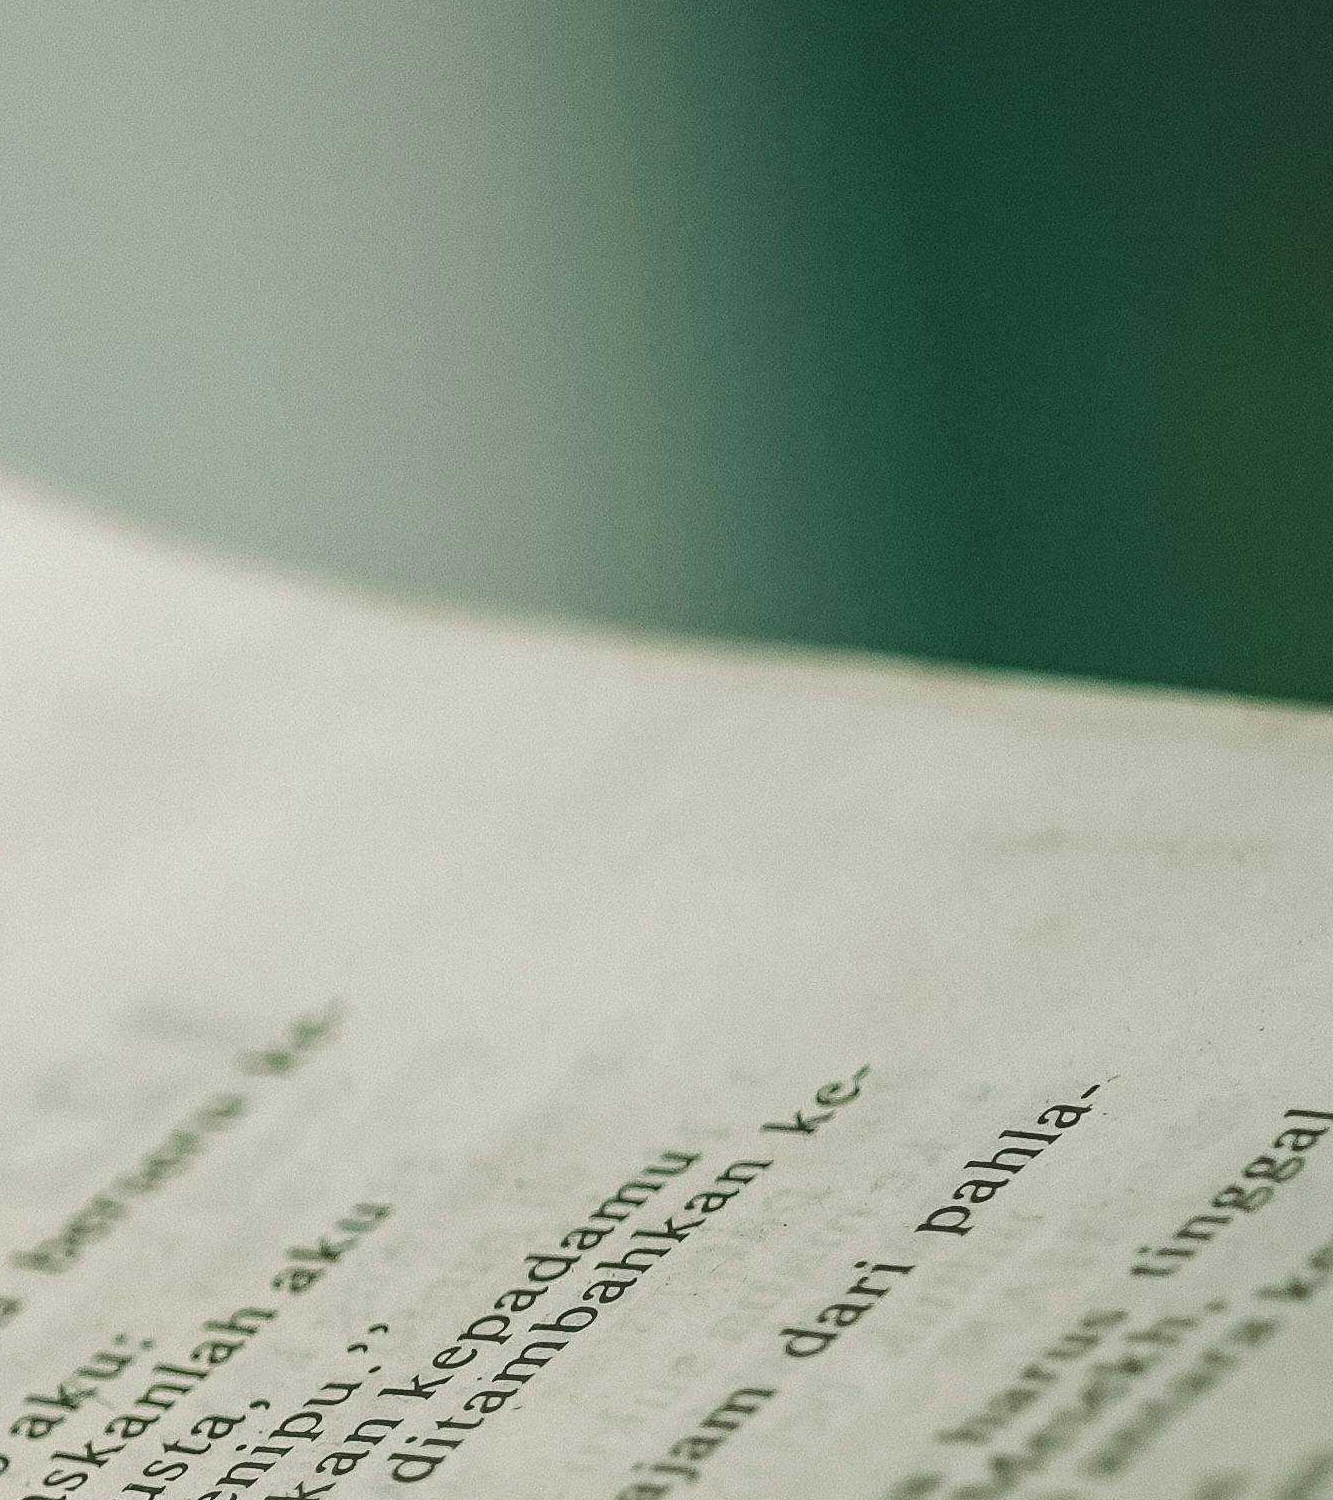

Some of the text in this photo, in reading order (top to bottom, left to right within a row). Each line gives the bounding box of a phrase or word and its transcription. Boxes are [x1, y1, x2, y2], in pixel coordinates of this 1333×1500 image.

[270, 1202, 392, 1292] aku
[377, 1151, 702, 1397] kepadamu
[386, 1159, 772, 1486] ditambahkan
[759, 1064, 871, 1135] ke-
[778, 1259, 915, 1358] dari
[914, 1082, 1101, 1237] pahla-
[1130, 1109, 1333, 1277] tinggal
[7, 1333, 155, 1439] aku:
